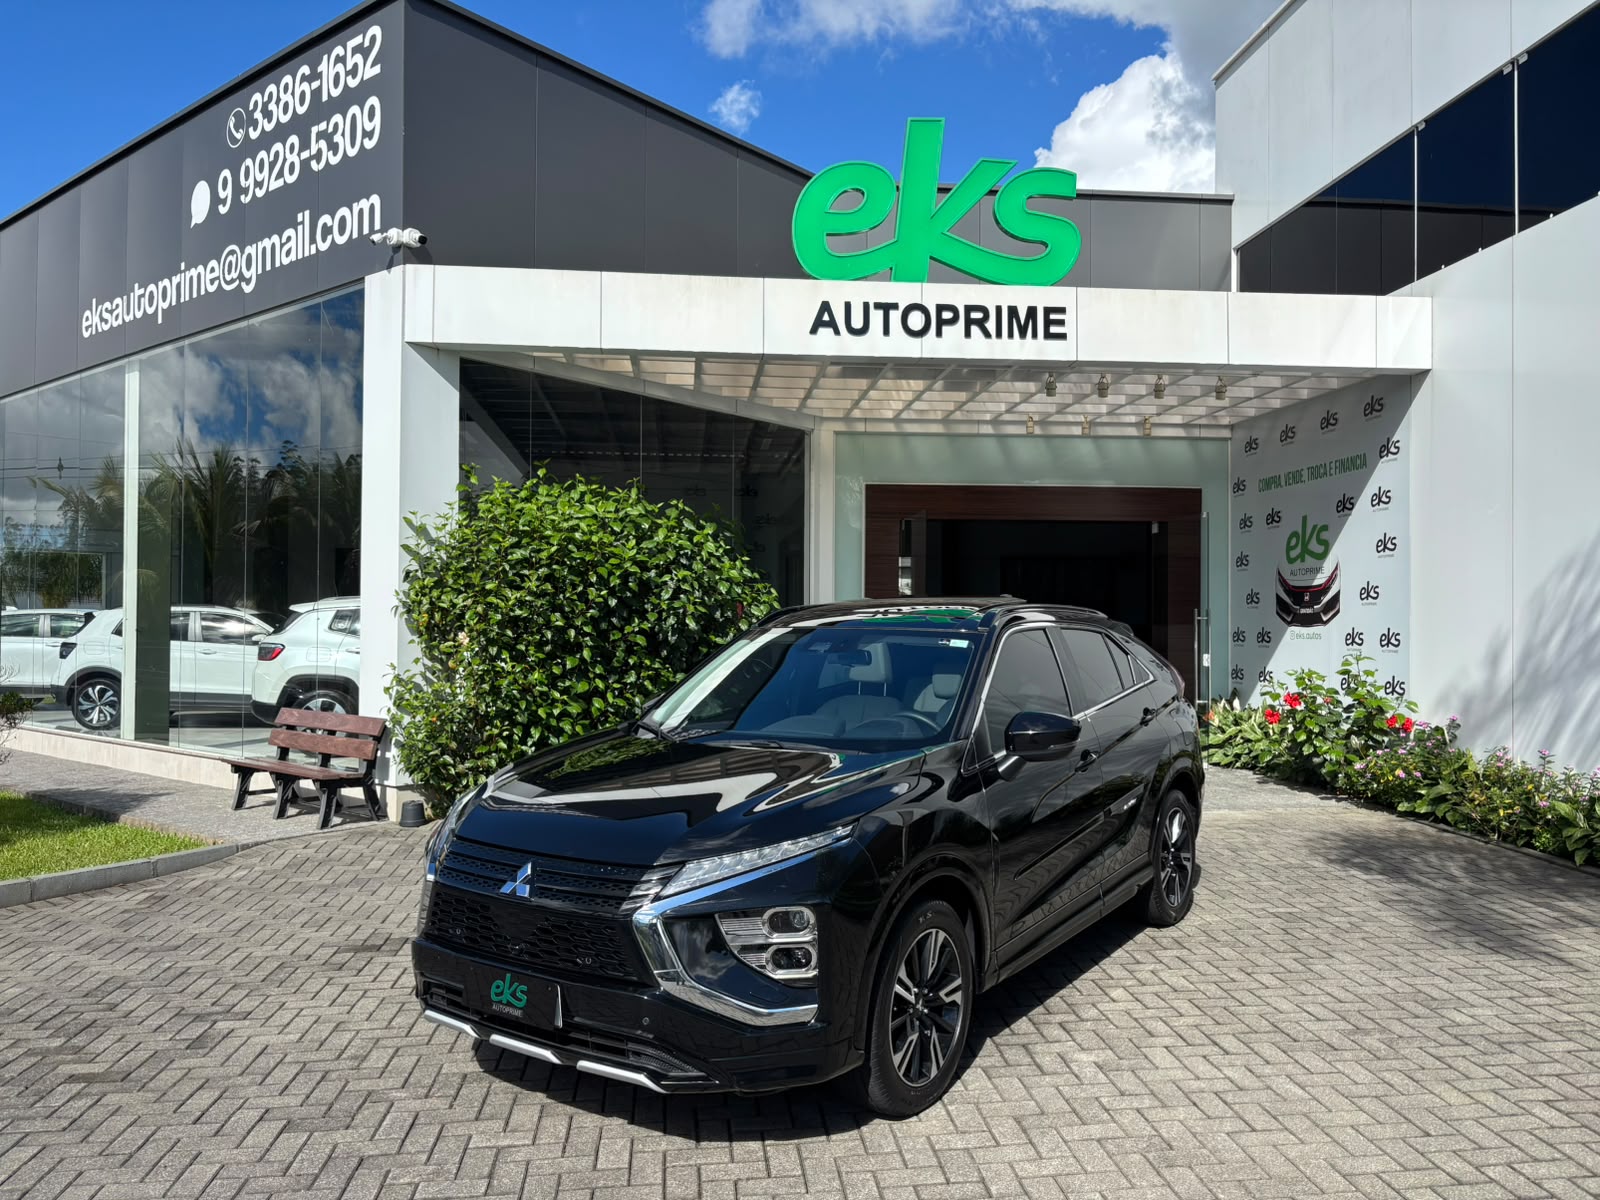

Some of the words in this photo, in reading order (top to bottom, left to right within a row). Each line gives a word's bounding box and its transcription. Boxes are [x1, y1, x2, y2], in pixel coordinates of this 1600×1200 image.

[248, 25, 382, 140] 3386-1652
[217, 169, 233, 215] 9
[239, 96, 382, 204] 9928-5309
[791, 116, 1082, 287] eks
[82, 194, 382, 338] eksautoprime@gmail.com
[809, 300, 1068, 341] AUTOPRIME
[1363, 395, 1384, 416] eks
[1320, 410, 1339, 430] eks
[1280, 424, 1296, 442] eks
[1244, 435, 1259, 453] eks
[1379, 437, 1400, 458] eks
[1307, 465, 1328, 482] TROCA
[1329, 461, 1334, 477] E
[1334, 453, 1368, 476] FINANCIA
[1232, 477, 1247, 493] eks
[1336, 493, 1355, 513] eks
[1370, 486, 1392, 507] eks
[1239, 513, 1253, 529] eks
[1265, 507, 1282, 525] eks
[1285, 515, 1330, 564] eks
[1376, 532, 1397, 553] eks
[1235, 551, 1250, 567] eks
[1289, 567, 1325, 577] AUTOPRIME
[1245, 588, 1260, 604] eks
[1359, 581, 1380, 600] eks
[1232, 627, 1247, 642] eks
[1256, 627, 1272, 643] eks
[1344, 627, 1364, 646] eks
[1379, 627, 1401, 648] eks
[1231, 664, 1245, 680] eks
[1384, 675, 1406, 695] eks
[490, 972, 528, 1009] eks
[492, 1003, 524, 1017] AUTOPRIME
